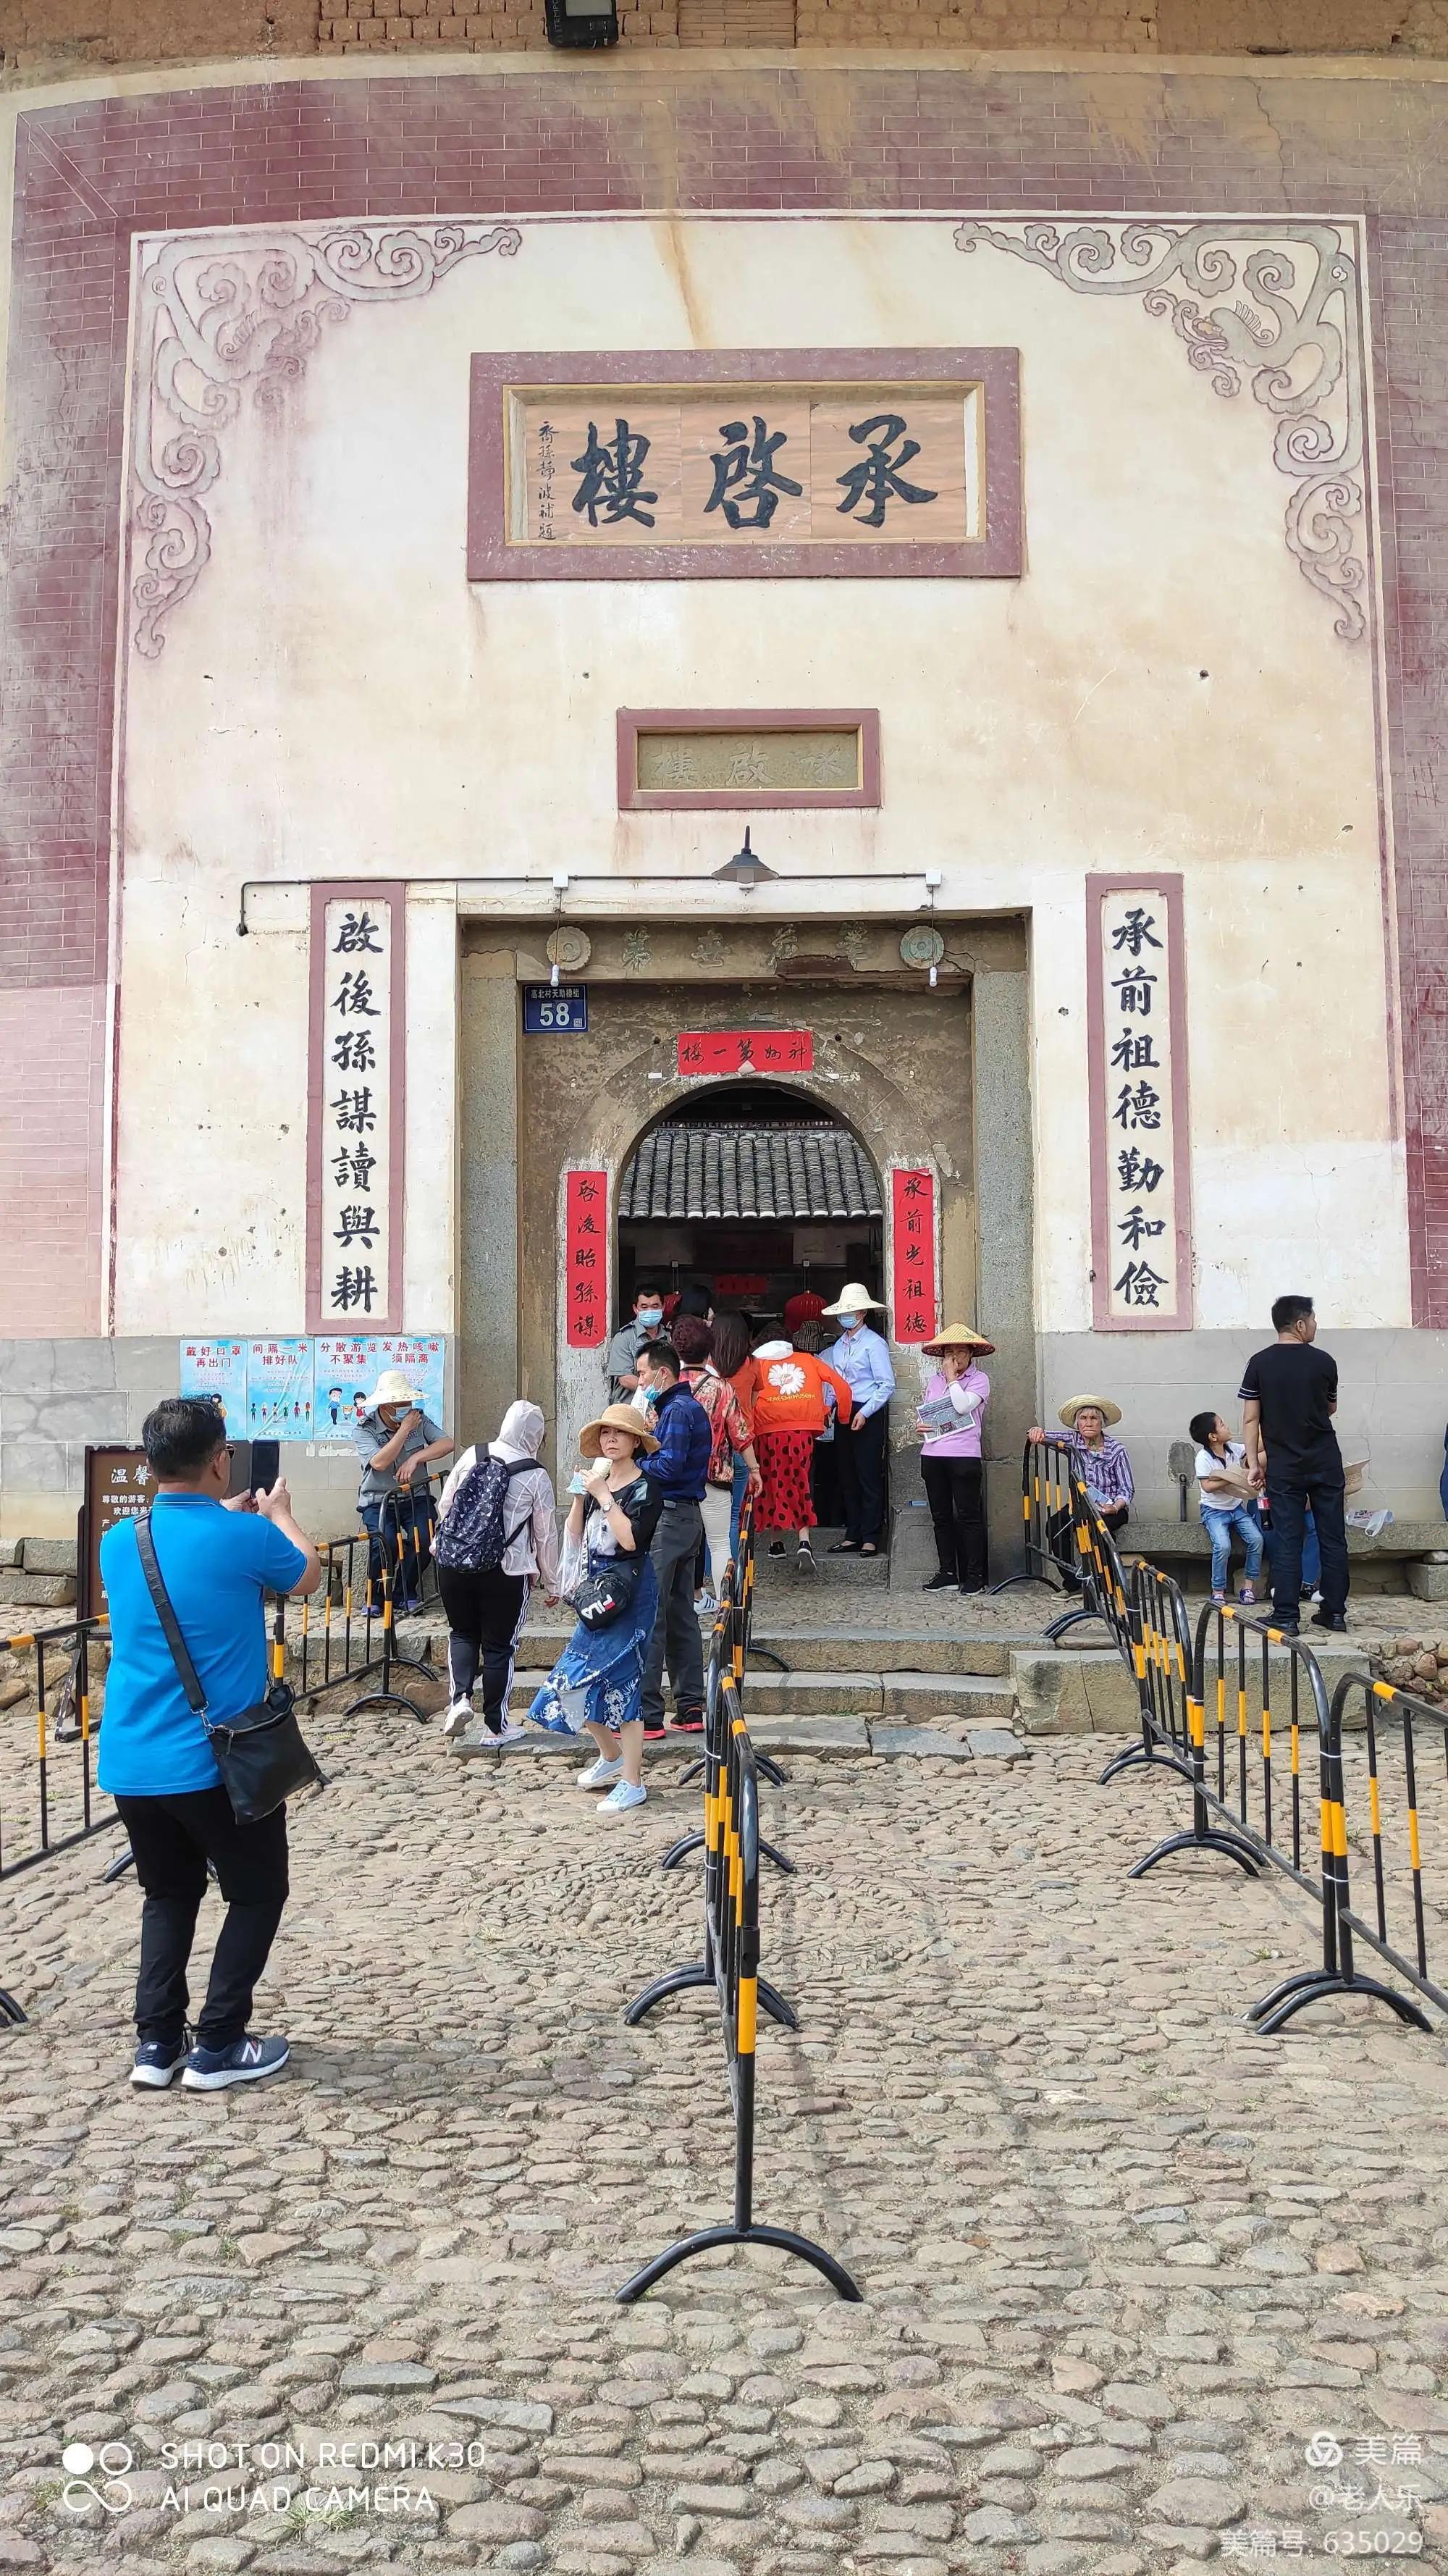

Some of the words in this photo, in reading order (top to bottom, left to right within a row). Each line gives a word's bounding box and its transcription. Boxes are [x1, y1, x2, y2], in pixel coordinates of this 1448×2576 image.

[539, 1002, 570, 1026] 58
[1111, 907, 1170, 1308] 承前祖德勤和儉
[185, 1346, 242, 1356] 戴好口罩
[253, 1343, 308, 1354] 间隔一米
[320, 1342, 377, 1353] 分散游览
[382, 1341, 439, 1352] 发热咳嗽
[196, 1358, 232, 1368] 再出门
[262, 1355, 298, 1366] 排好队
[329, 1354, 367, 1364] 不聚集
[391, 1353, 429, 1364] 须隔离
[111, 1464, 152, 1486] 温馨
[113, 1506, 153, 1516] 欢迎您来
[581, 1594, 615, 1620] FILA
